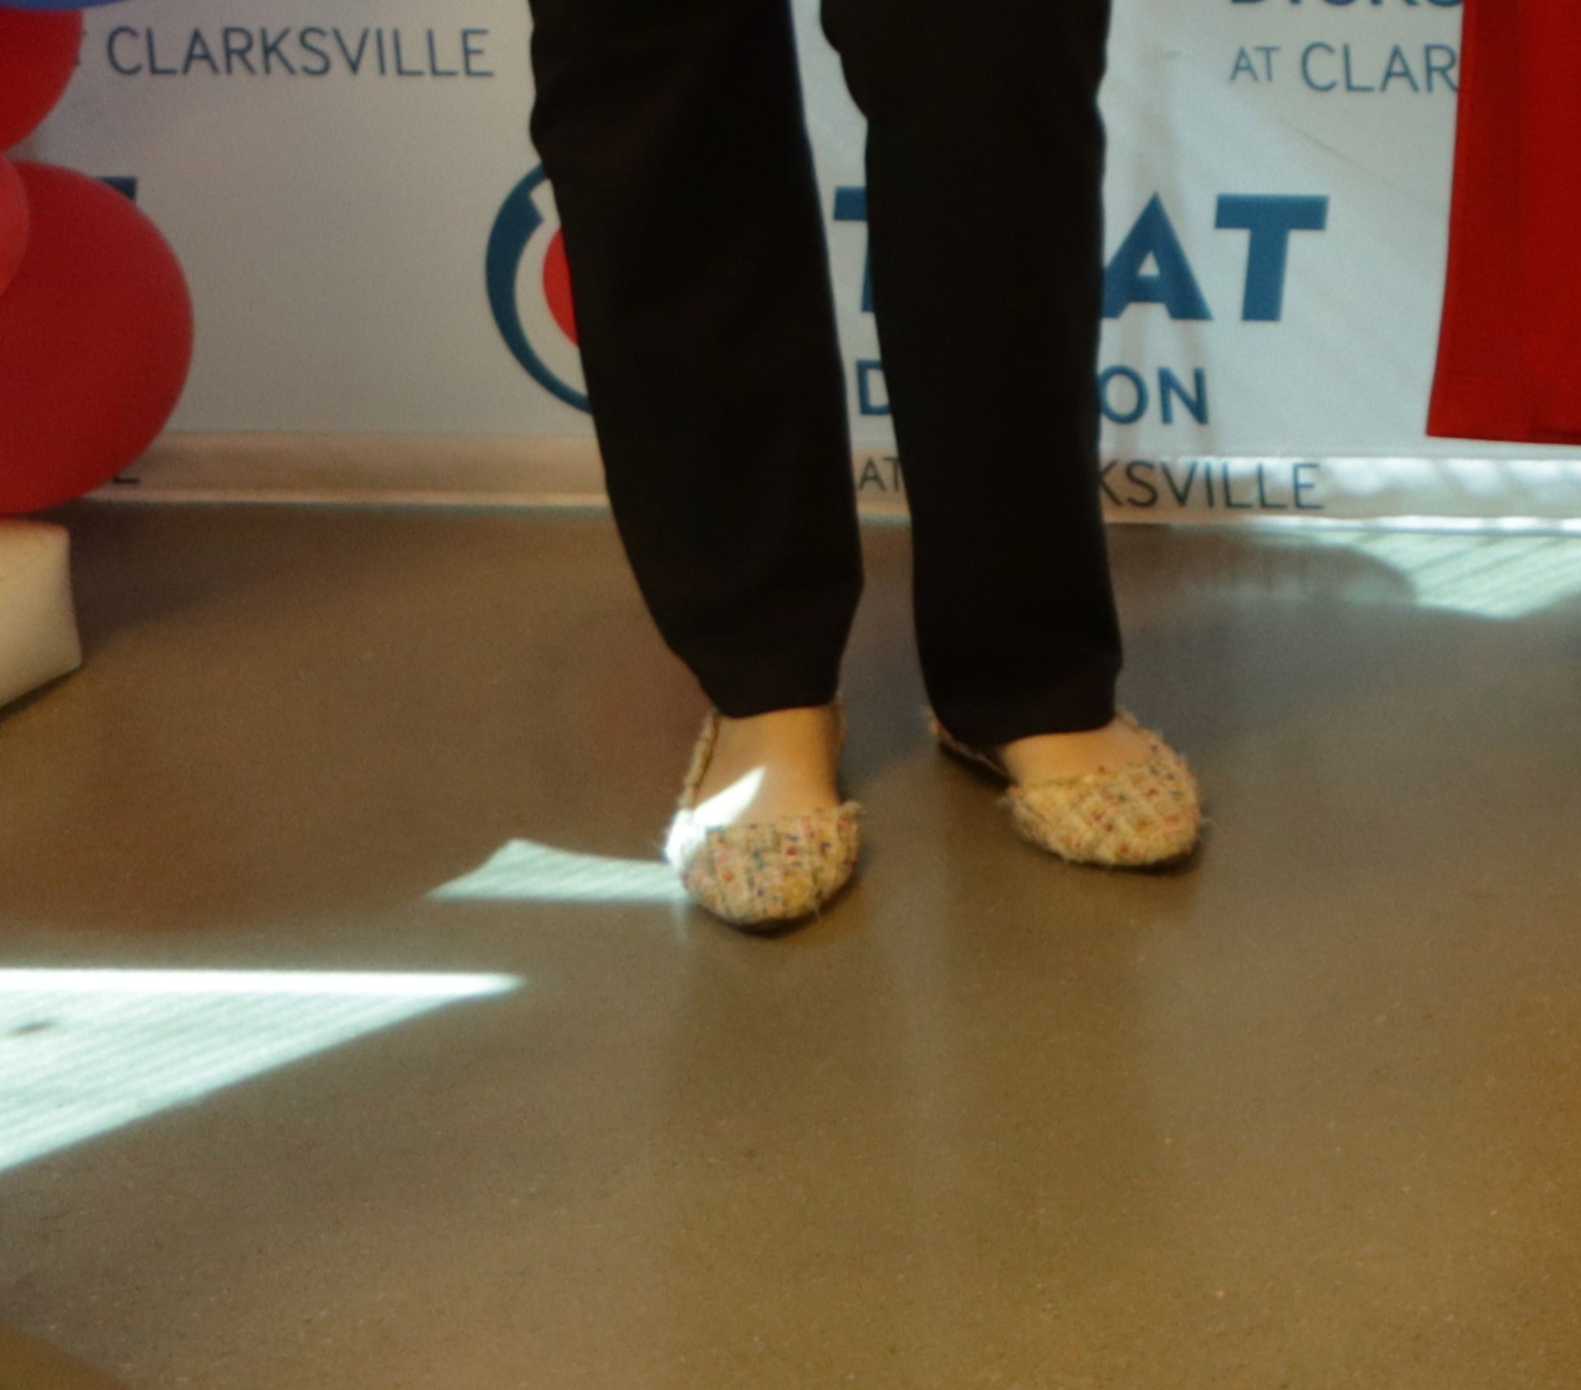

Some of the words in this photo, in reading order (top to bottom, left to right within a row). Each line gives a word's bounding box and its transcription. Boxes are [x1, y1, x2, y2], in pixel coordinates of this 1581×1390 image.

[106, 25, 496, 77] CLARKSVILLE
[1229, 45, 1282, 83] AT
[1101, 458, 1326, 511] SVILLE
